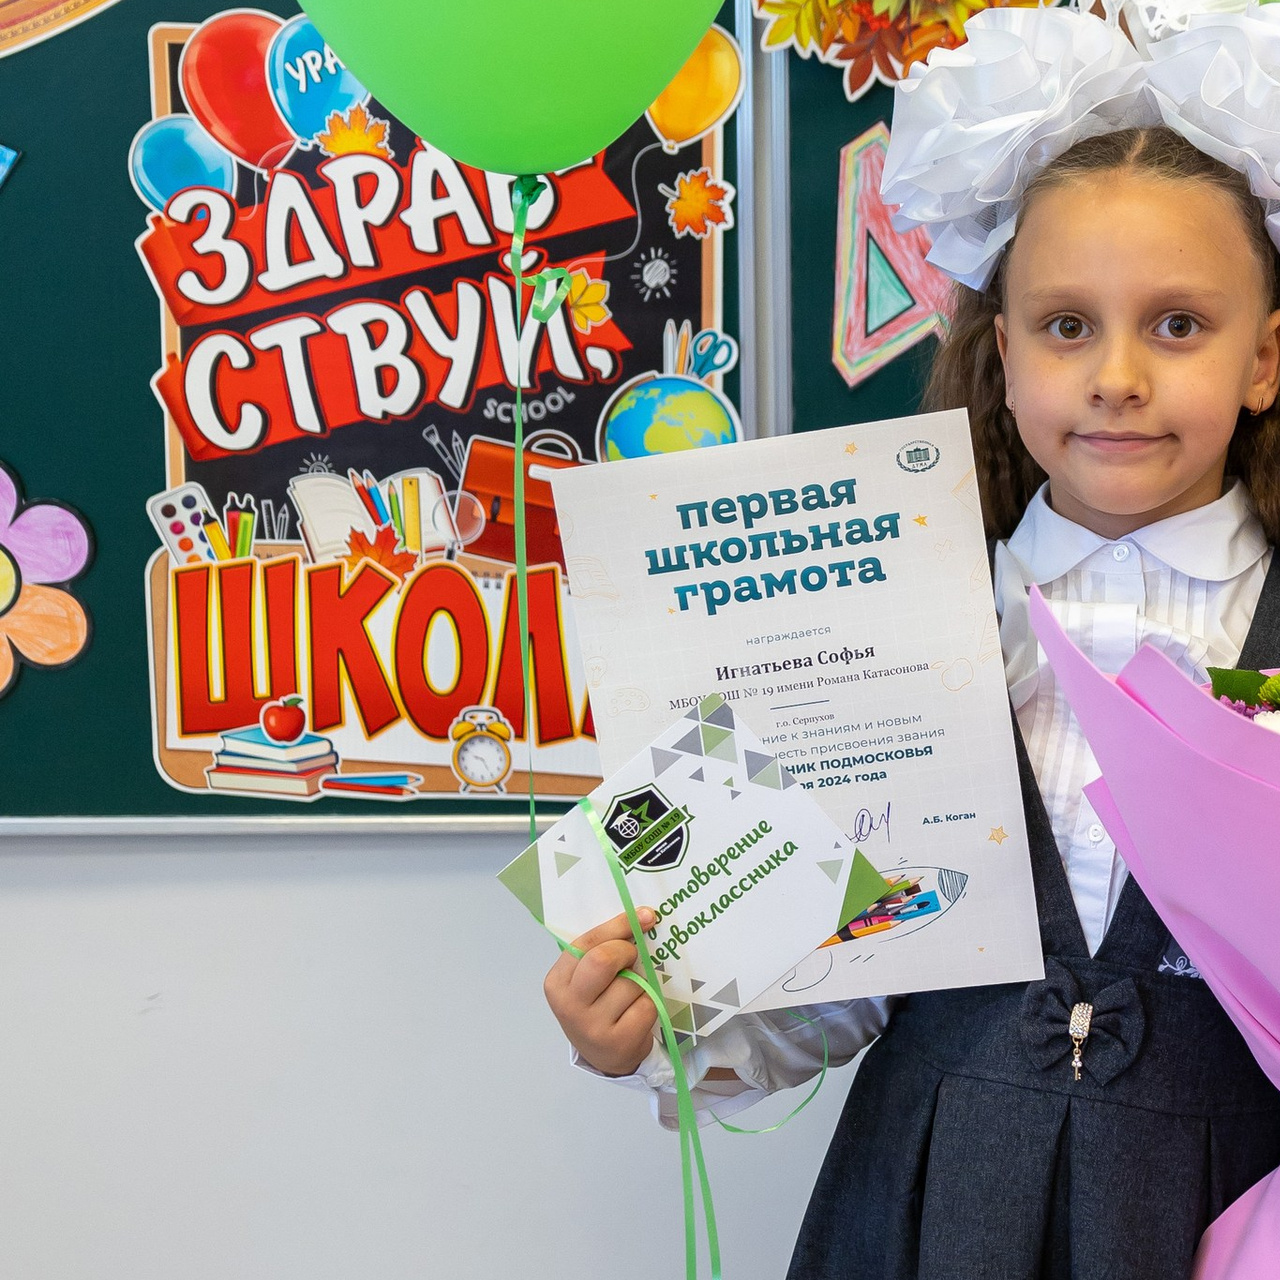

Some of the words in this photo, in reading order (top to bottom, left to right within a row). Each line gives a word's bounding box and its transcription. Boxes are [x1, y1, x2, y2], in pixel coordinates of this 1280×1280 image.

[483, 385, 577, 424] SCHOOL
[676, 478, 857, 530] первая
[644, 512, 901, 576] школьная
[673, 556, 887, 616] грамота
[172, 557, 598, 745] ШКОЛ
[746, 625, 831, 646] награждается
[715, 655, 813, 681] Игнатьева
[817, 646, 875, 665] Софья
[762, 686, 774, 697] 19
[777, 679, 814, 694] имени
[816, 673, 860, 689] Романа
[863, 661, 929, 681] Катасонова
[793, 713, 835, 727] Серпухов
[802, 723, 861, 739] знаниям
[865, 721, 874, 730] и
[877, 713, 922, 729] новым
[810, 734, 893, 756] присвоения
[897, 727, 945, 743] звания
[820, 744, 933, 770] ПОДМОСКОВЬЯ
[817, 773, 851, 788] 2024
[855, 770, 888, 783] года
[922, 816, 943, 825] А.Б.
[946, 812, 976, 822] Коган
[623, 841, 644, 862] МБОУ
[644, 827, 663, 844] СОШ
[670, 812, 681, 823] 19
